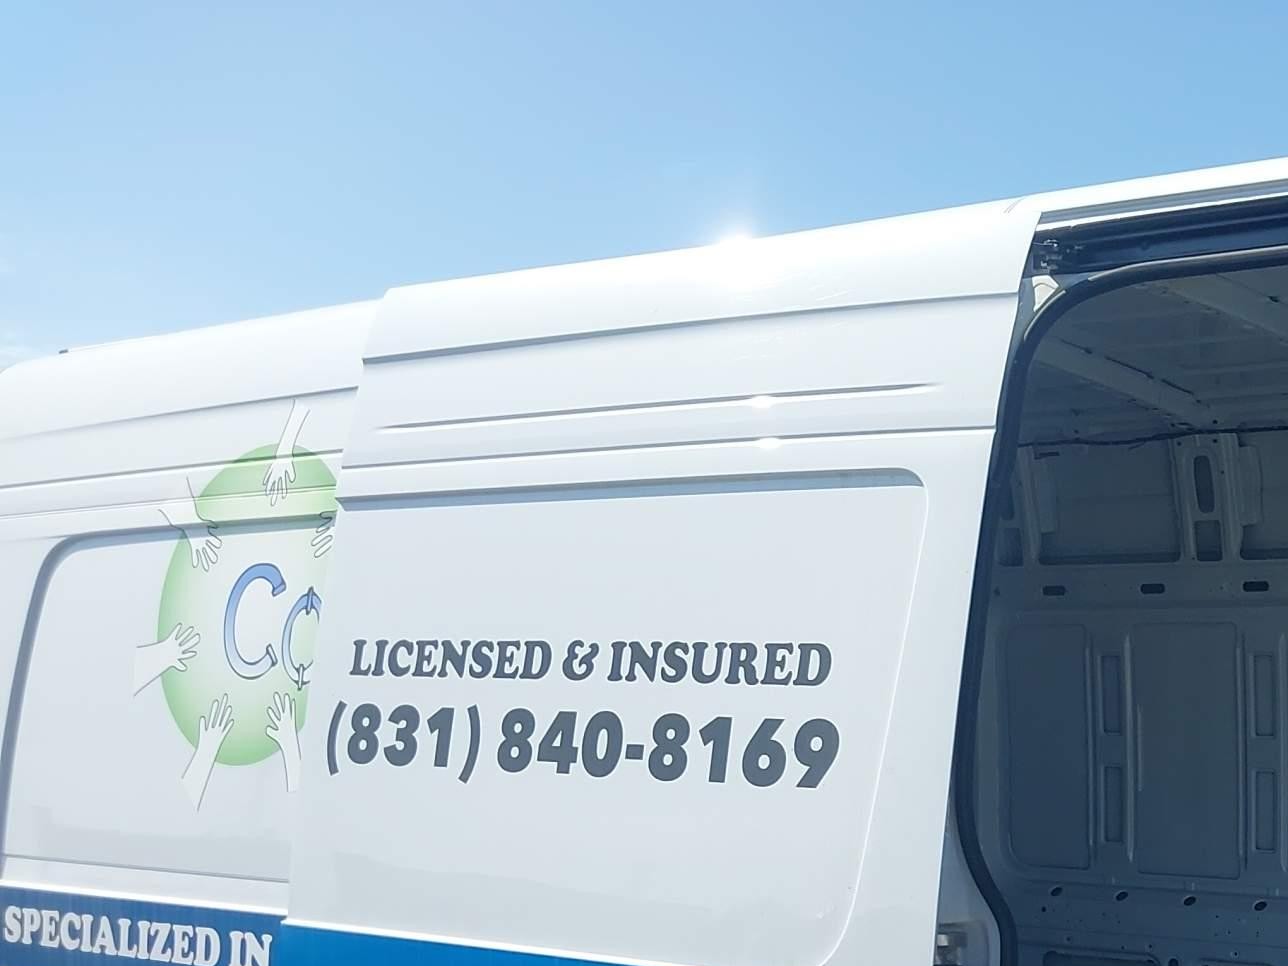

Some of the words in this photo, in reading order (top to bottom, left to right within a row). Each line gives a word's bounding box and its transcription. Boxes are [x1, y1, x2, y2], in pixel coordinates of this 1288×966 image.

[350, 639, 552, 680] LICENSED
[562, 639, 600, 682] &
[606, 641, 833, 687] INSURED
[327, 701, 480, 784] (831)
[497, 707, 840, 789] 840-8169
